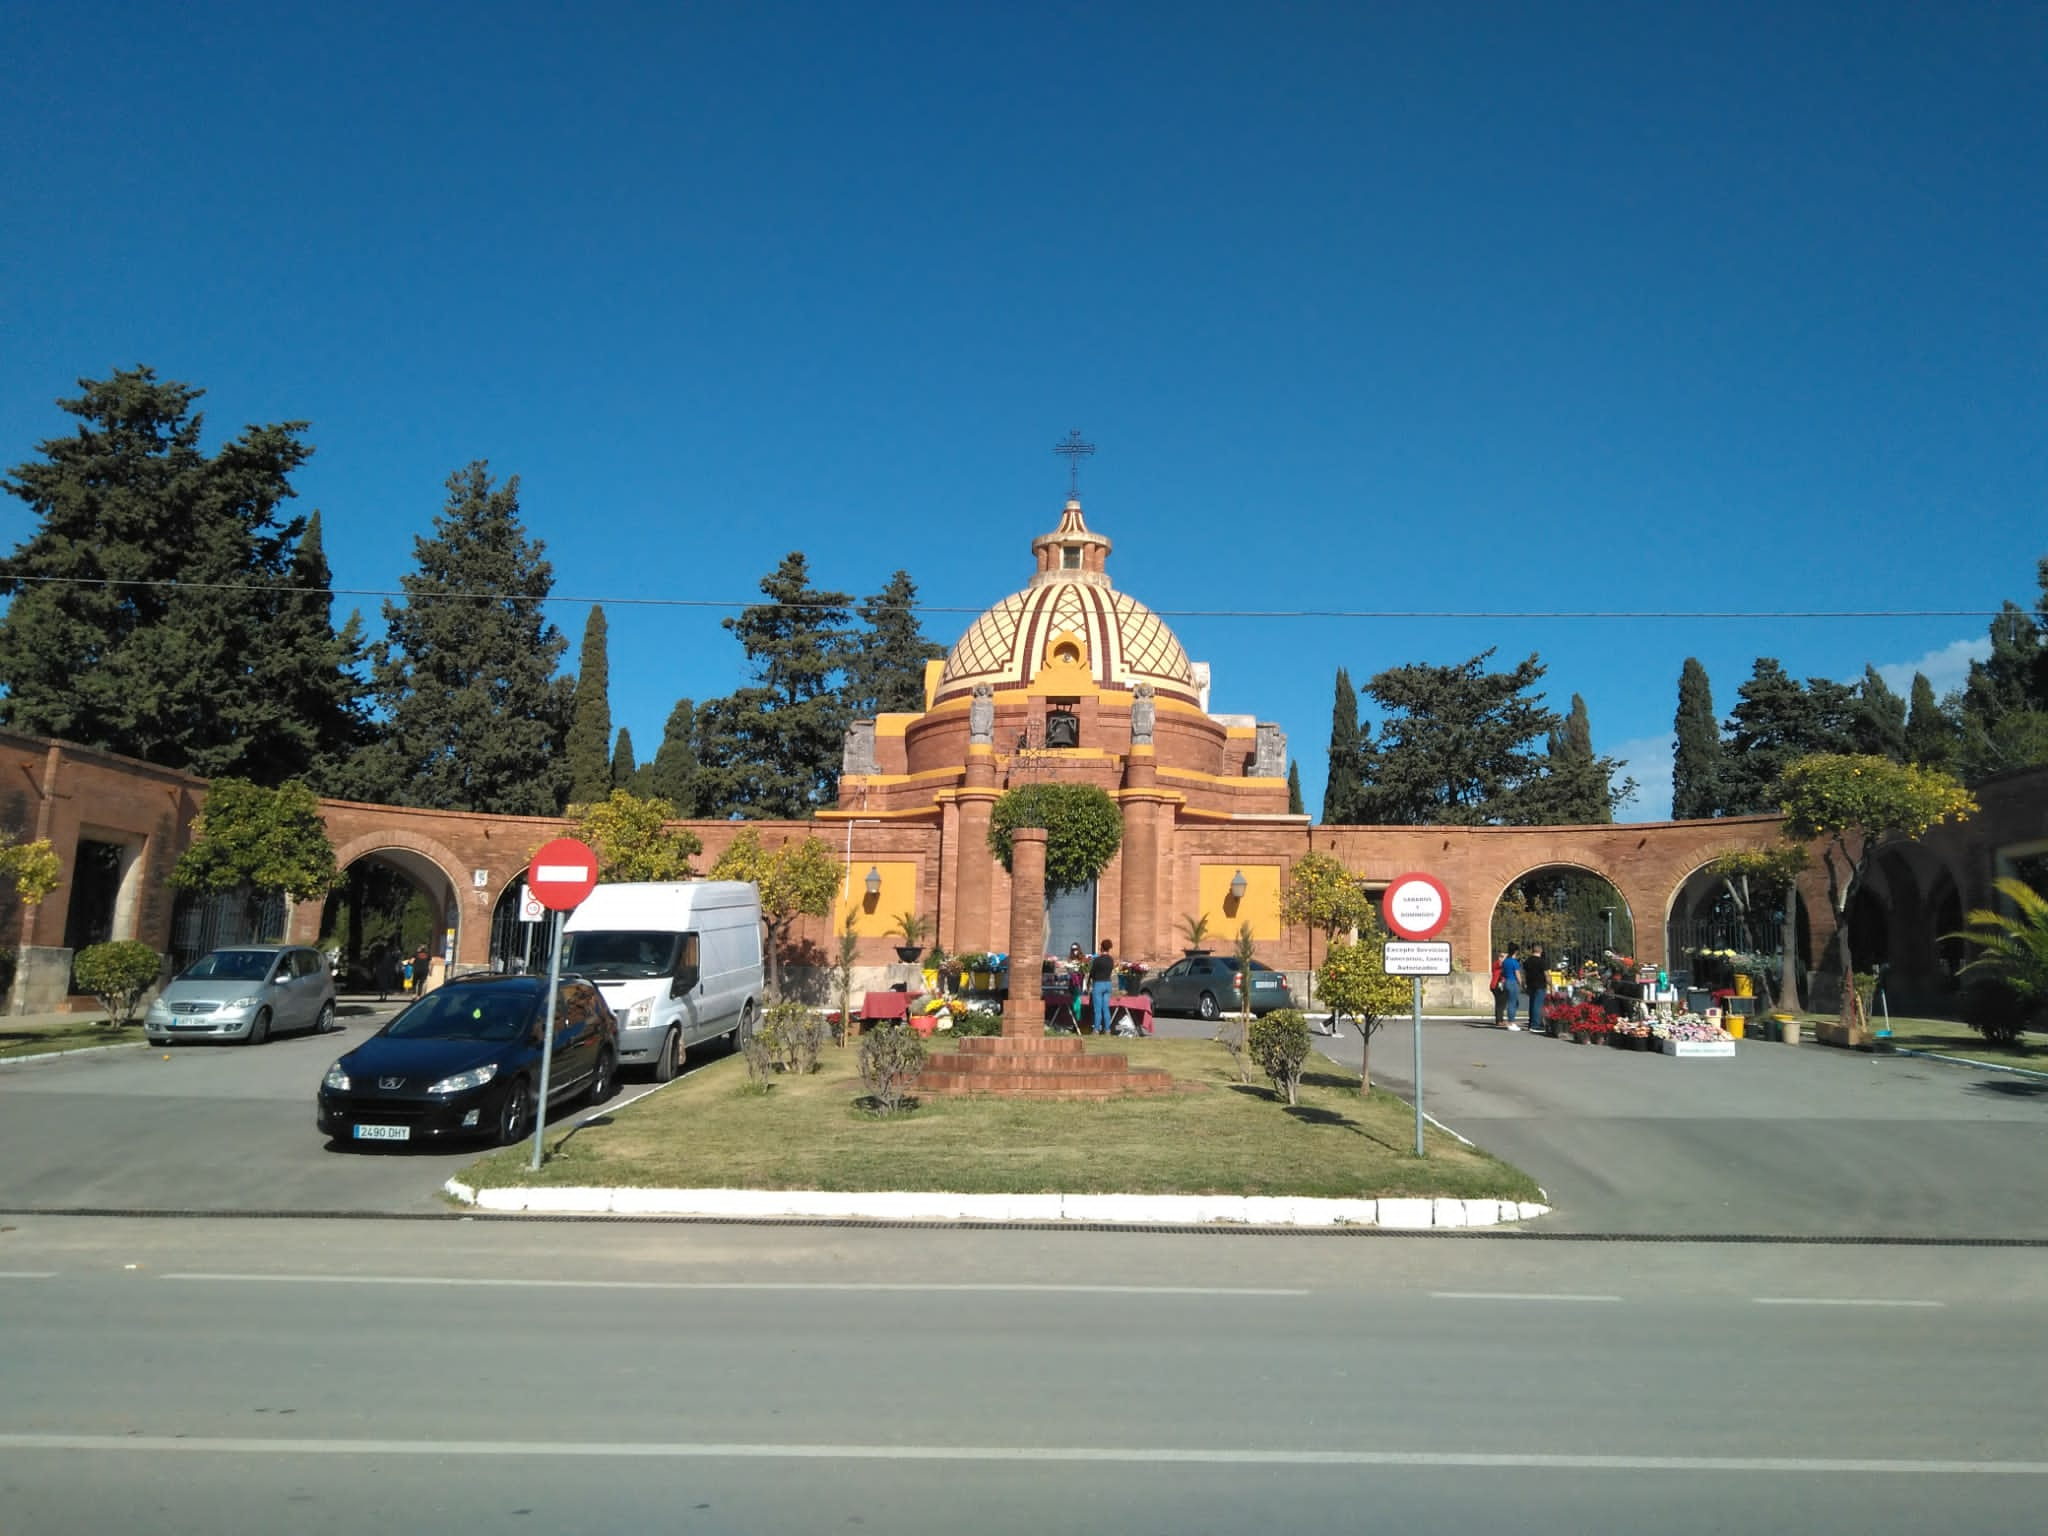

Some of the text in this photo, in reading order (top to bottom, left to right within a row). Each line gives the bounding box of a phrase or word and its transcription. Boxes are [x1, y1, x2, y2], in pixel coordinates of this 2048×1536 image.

[1386, 946, 1415, 954] Excepto
[361, 1127, 407, 1138] 2490 DHY
